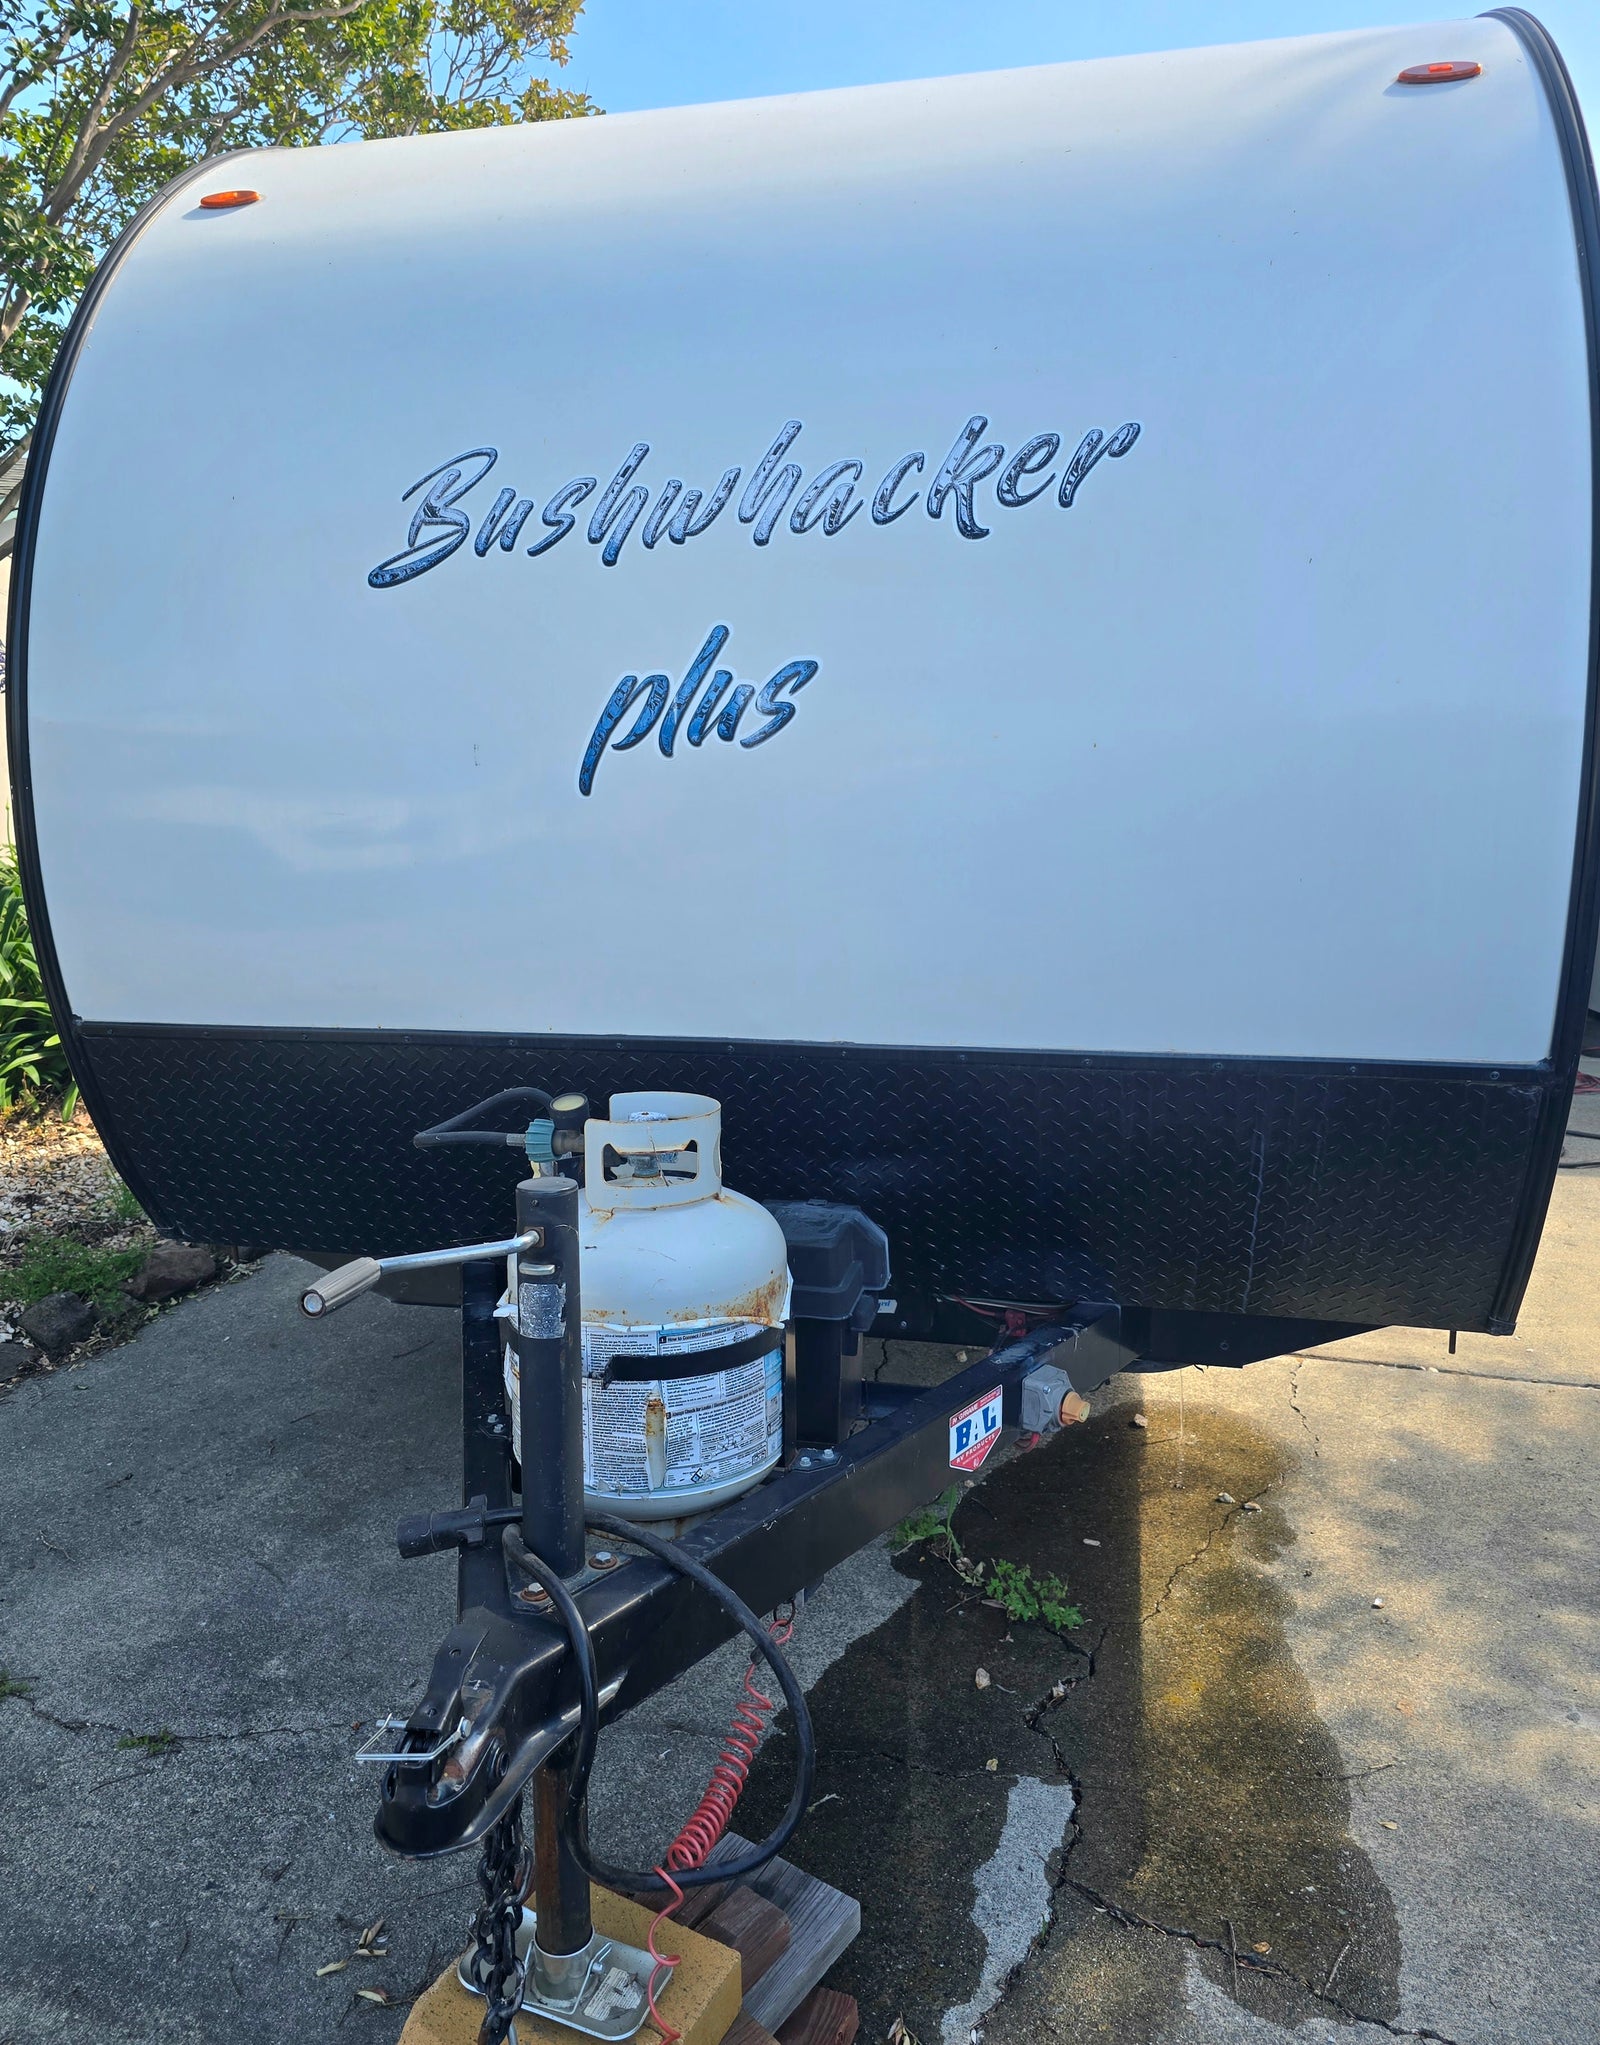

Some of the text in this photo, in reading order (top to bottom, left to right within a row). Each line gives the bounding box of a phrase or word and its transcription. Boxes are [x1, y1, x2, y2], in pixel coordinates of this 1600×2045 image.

[367, 415, 1142, 588] Bushwhacker
[577, 624, 819, 797] plus
[955, 1405, 997, 1455] BAL
[965, 1433, 996, 1458] PRODUCTS
